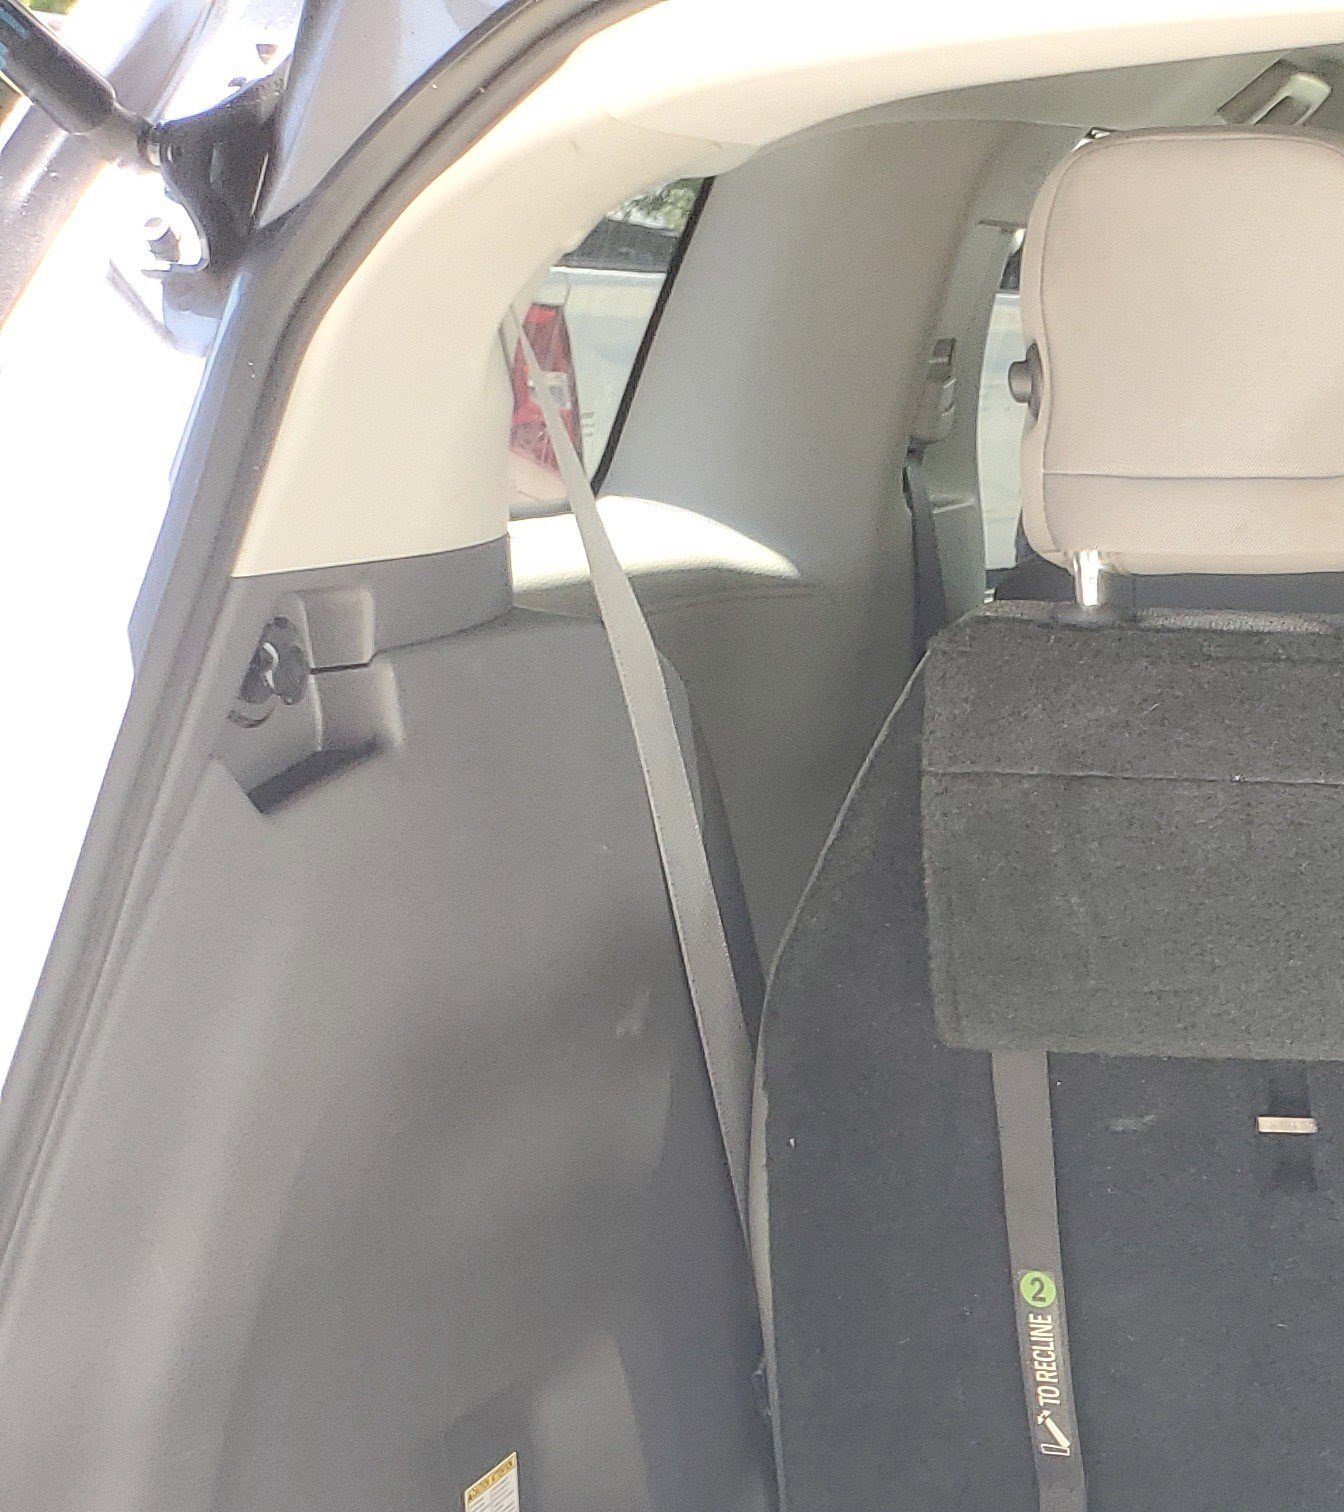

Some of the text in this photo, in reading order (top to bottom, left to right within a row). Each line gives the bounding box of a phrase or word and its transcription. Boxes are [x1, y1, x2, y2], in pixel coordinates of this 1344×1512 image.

[1030, 1277, 1046, 1302] 2
[1028, 1313, 1061, 1407] TO RECLINE
